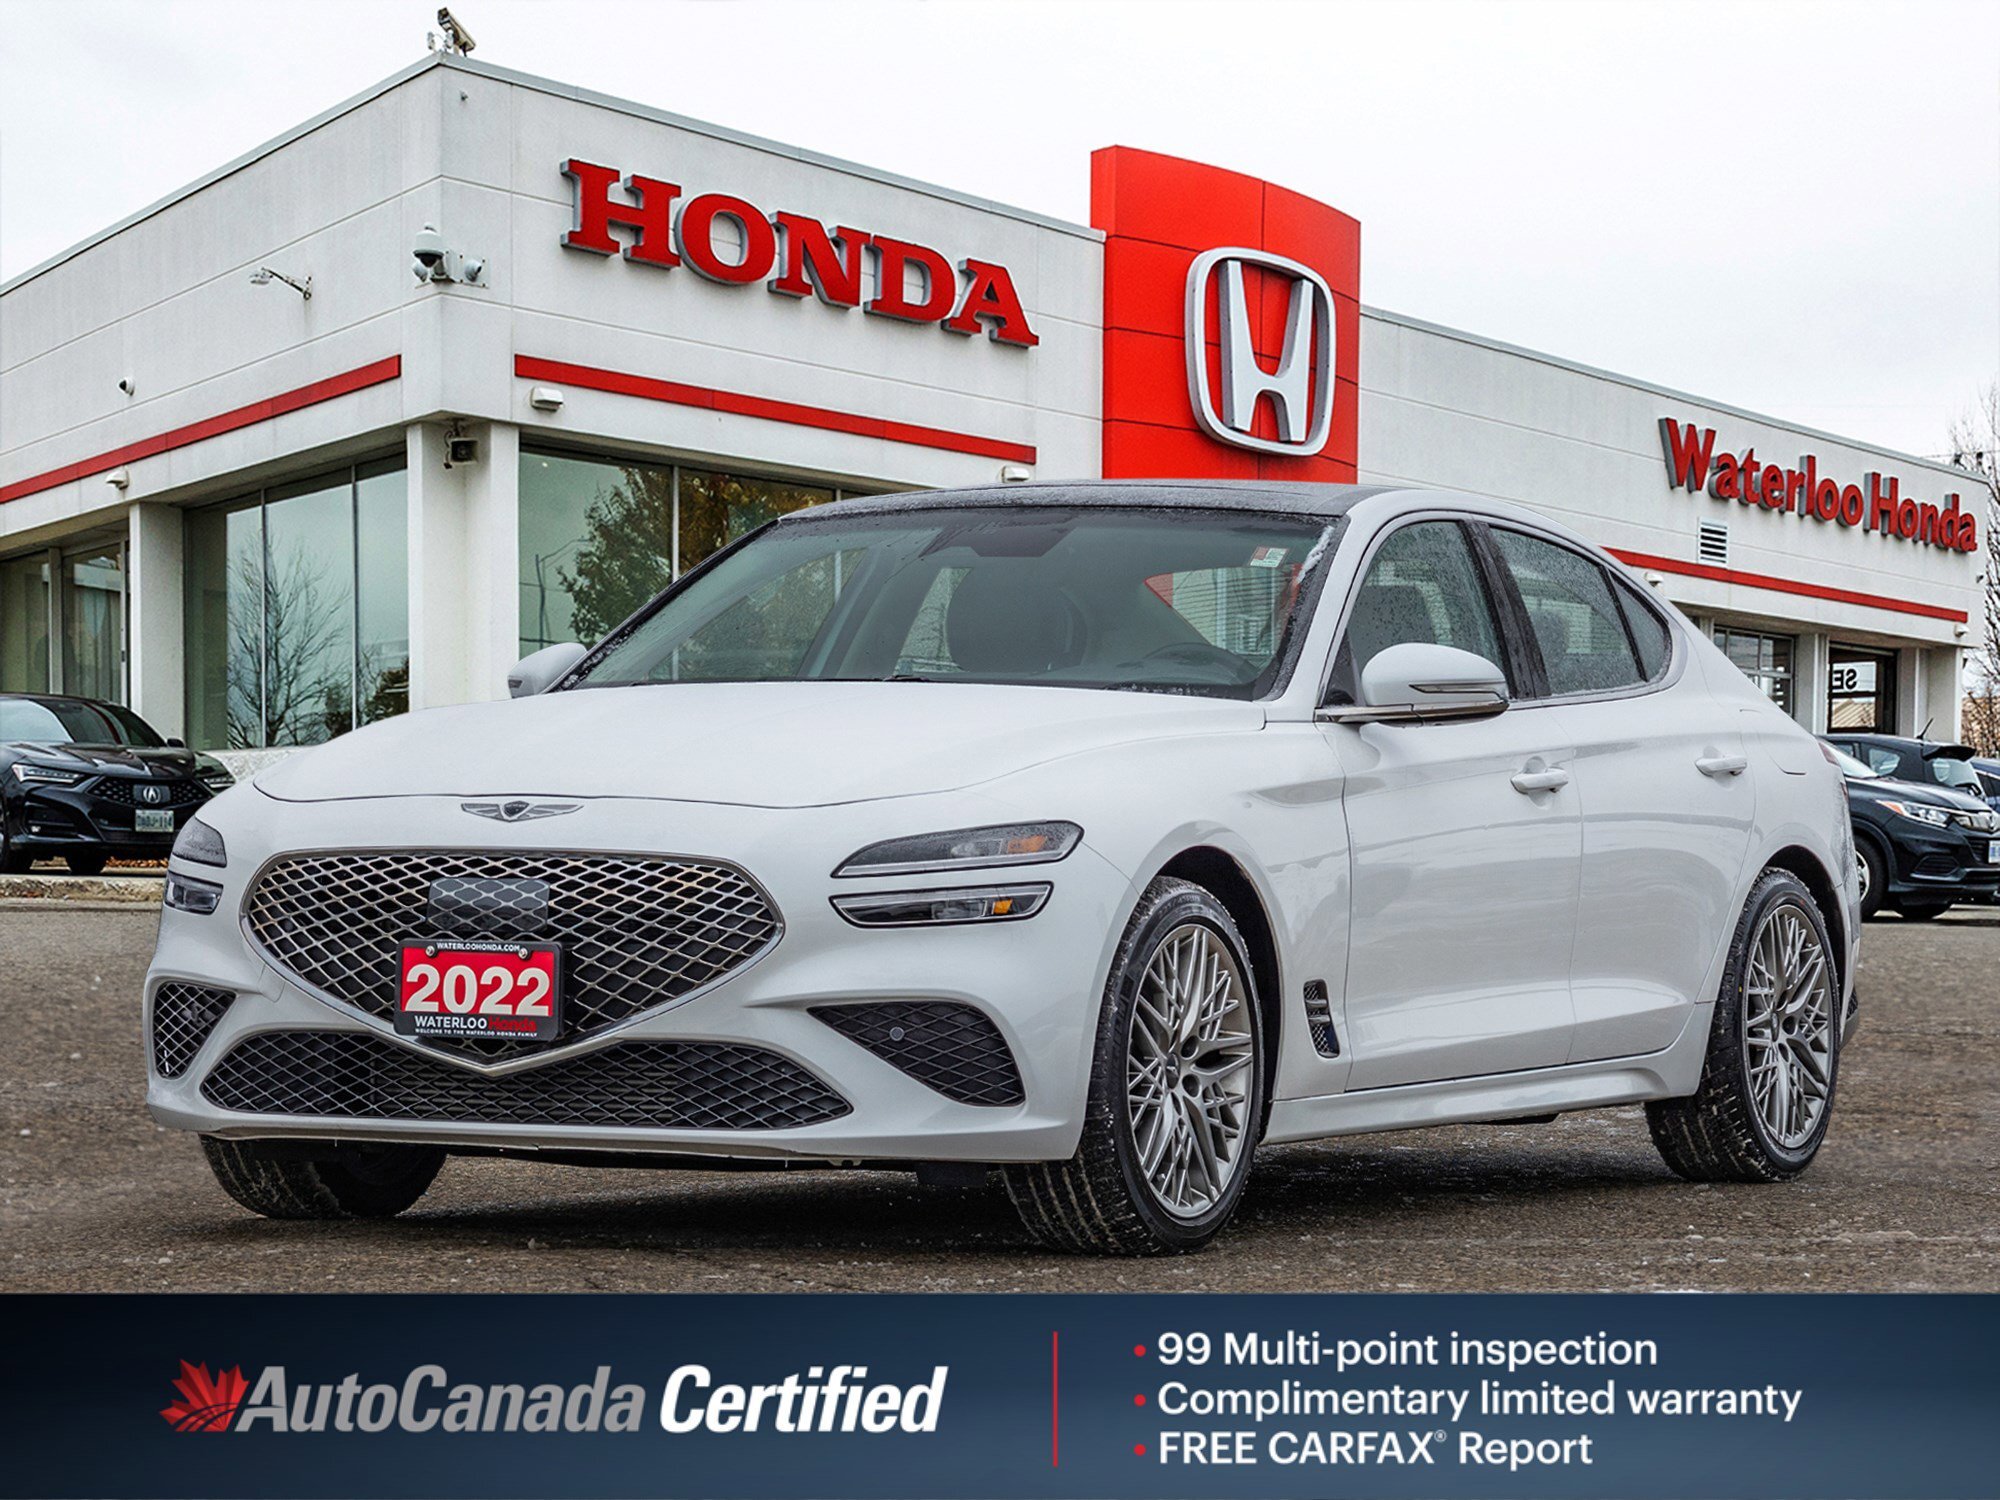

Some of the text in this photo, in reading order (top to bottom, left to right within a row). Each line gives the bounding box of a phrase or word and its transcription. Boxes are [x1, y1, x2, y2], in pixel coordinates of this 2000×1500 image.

[560, 158, 1040, 347] HONDA
[436, 942, 520, 952] WATERLOOHONDA.COM
[404, 963, 550, 1017] 2022
[414, 1015, 537, 1032] WATERLOO Honda
